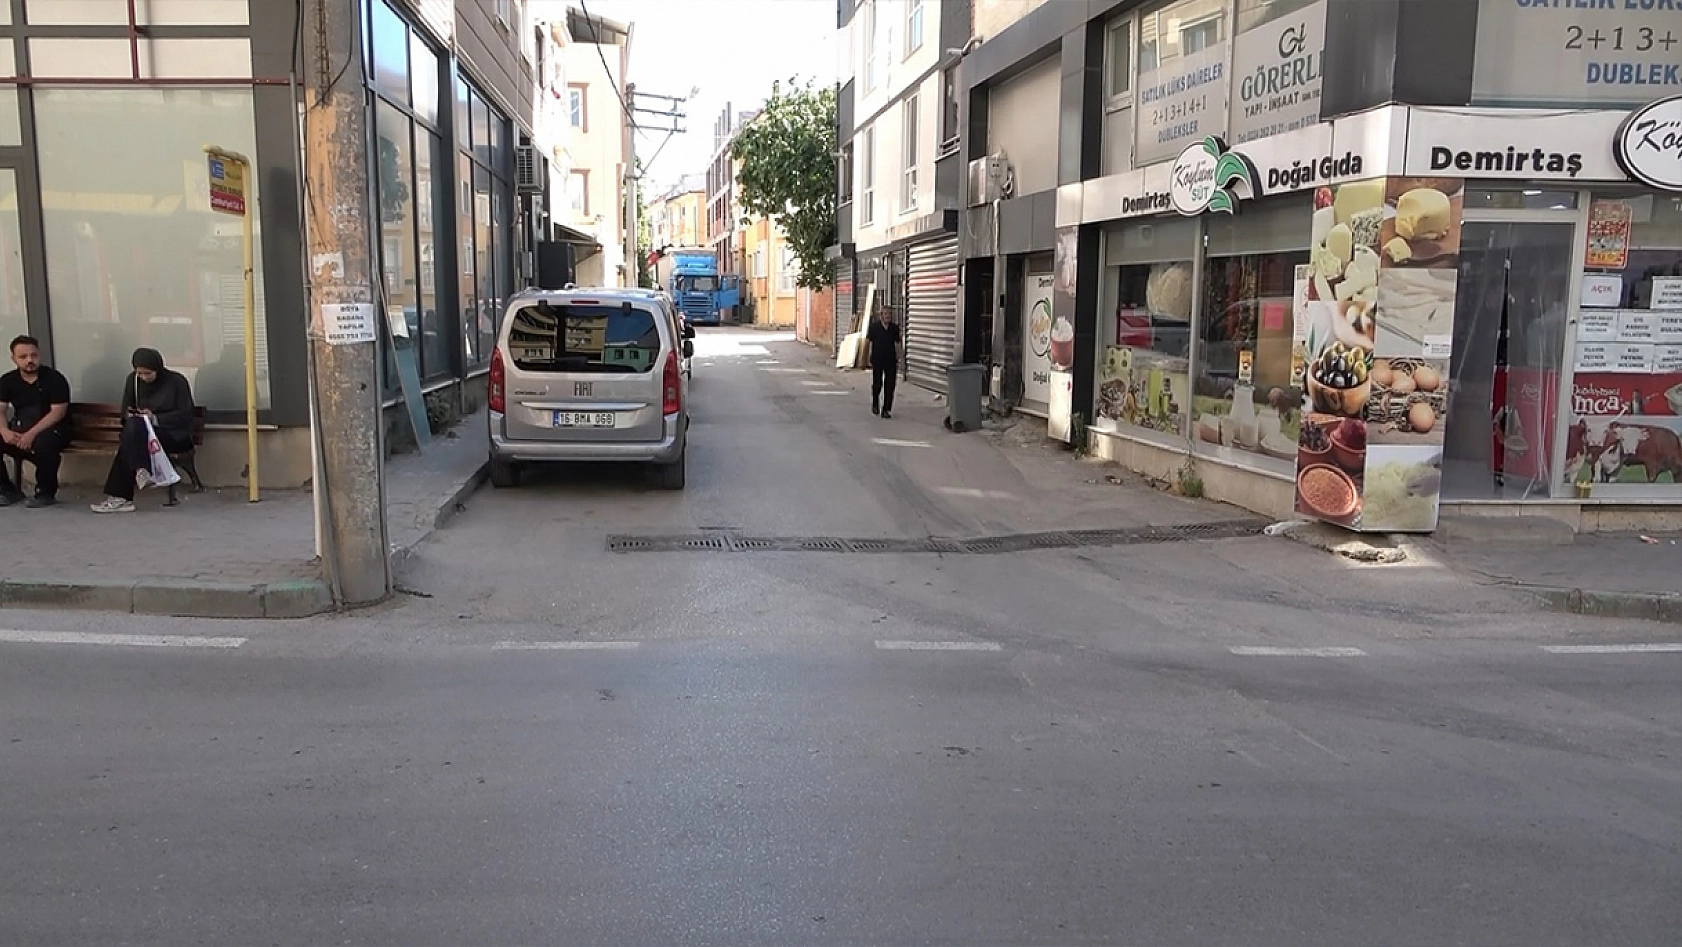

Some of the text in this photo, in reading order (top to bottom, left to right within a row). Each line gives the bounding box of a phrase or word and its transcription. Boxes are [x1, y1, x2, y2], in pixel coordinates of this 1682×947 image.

[1565, 25, 1625, 51] 2+1
[1586, 62, 1682, 85] DUBLEK
[1168, 76, 1186, 96] LÜKS
[1244, 102, 1263, 119] YAPI
[1268, 90, 1299, 112] İNŞAAT
[1158, 119, 1198, 143] DUBLEKSLER
[1268, 151, 1363, 190] Doğal Gıda
[1430, 146, 1583, 178] Demirtaş
[1123, 191, 1171, 214] Demirtaş
[1192, 184, 1209, 202] SÜT
[1591, 285, 1613, 294] AÇIK
[574, 382, 594, 397] FIAT
[561, 413, 570, 423] 16
[574, 413, 591, 424] BMA
